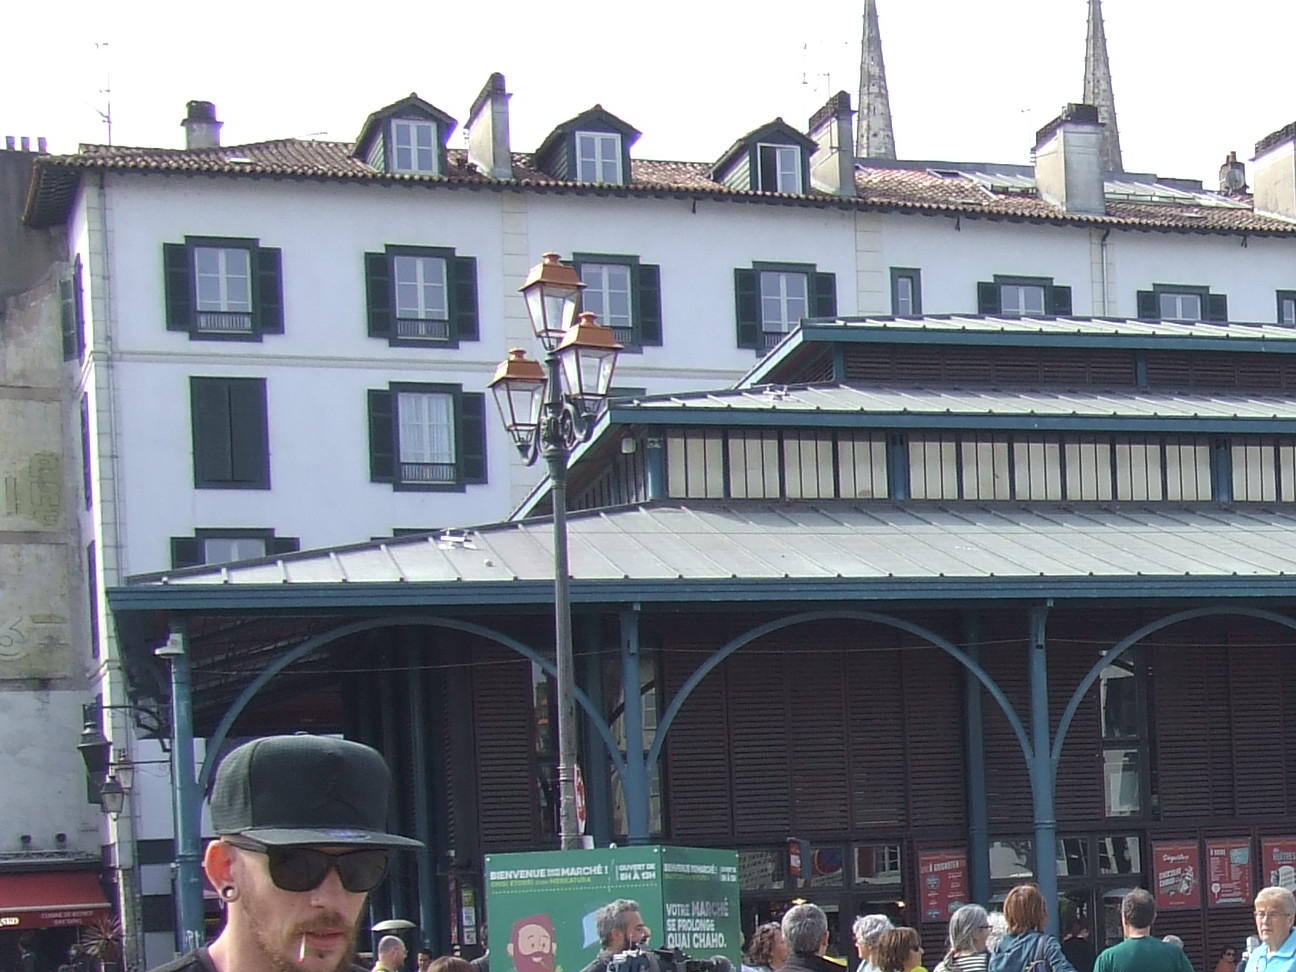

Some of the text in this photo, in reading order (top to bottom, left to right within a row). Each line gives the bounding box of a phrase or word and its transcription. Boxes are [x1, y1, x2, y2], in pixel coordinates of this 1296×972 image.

[489, 868, 546, 880] BIENVENUE
[561, 864, 603, 876] MARCHÉ
[619, 863, 646, 871] OUVERT
[666, 897, 729, 917] VOTRE MARCHÉ
[667, 919, 716, 932] SE PROLONGE
[667, 933, 691, 949] QUAI
